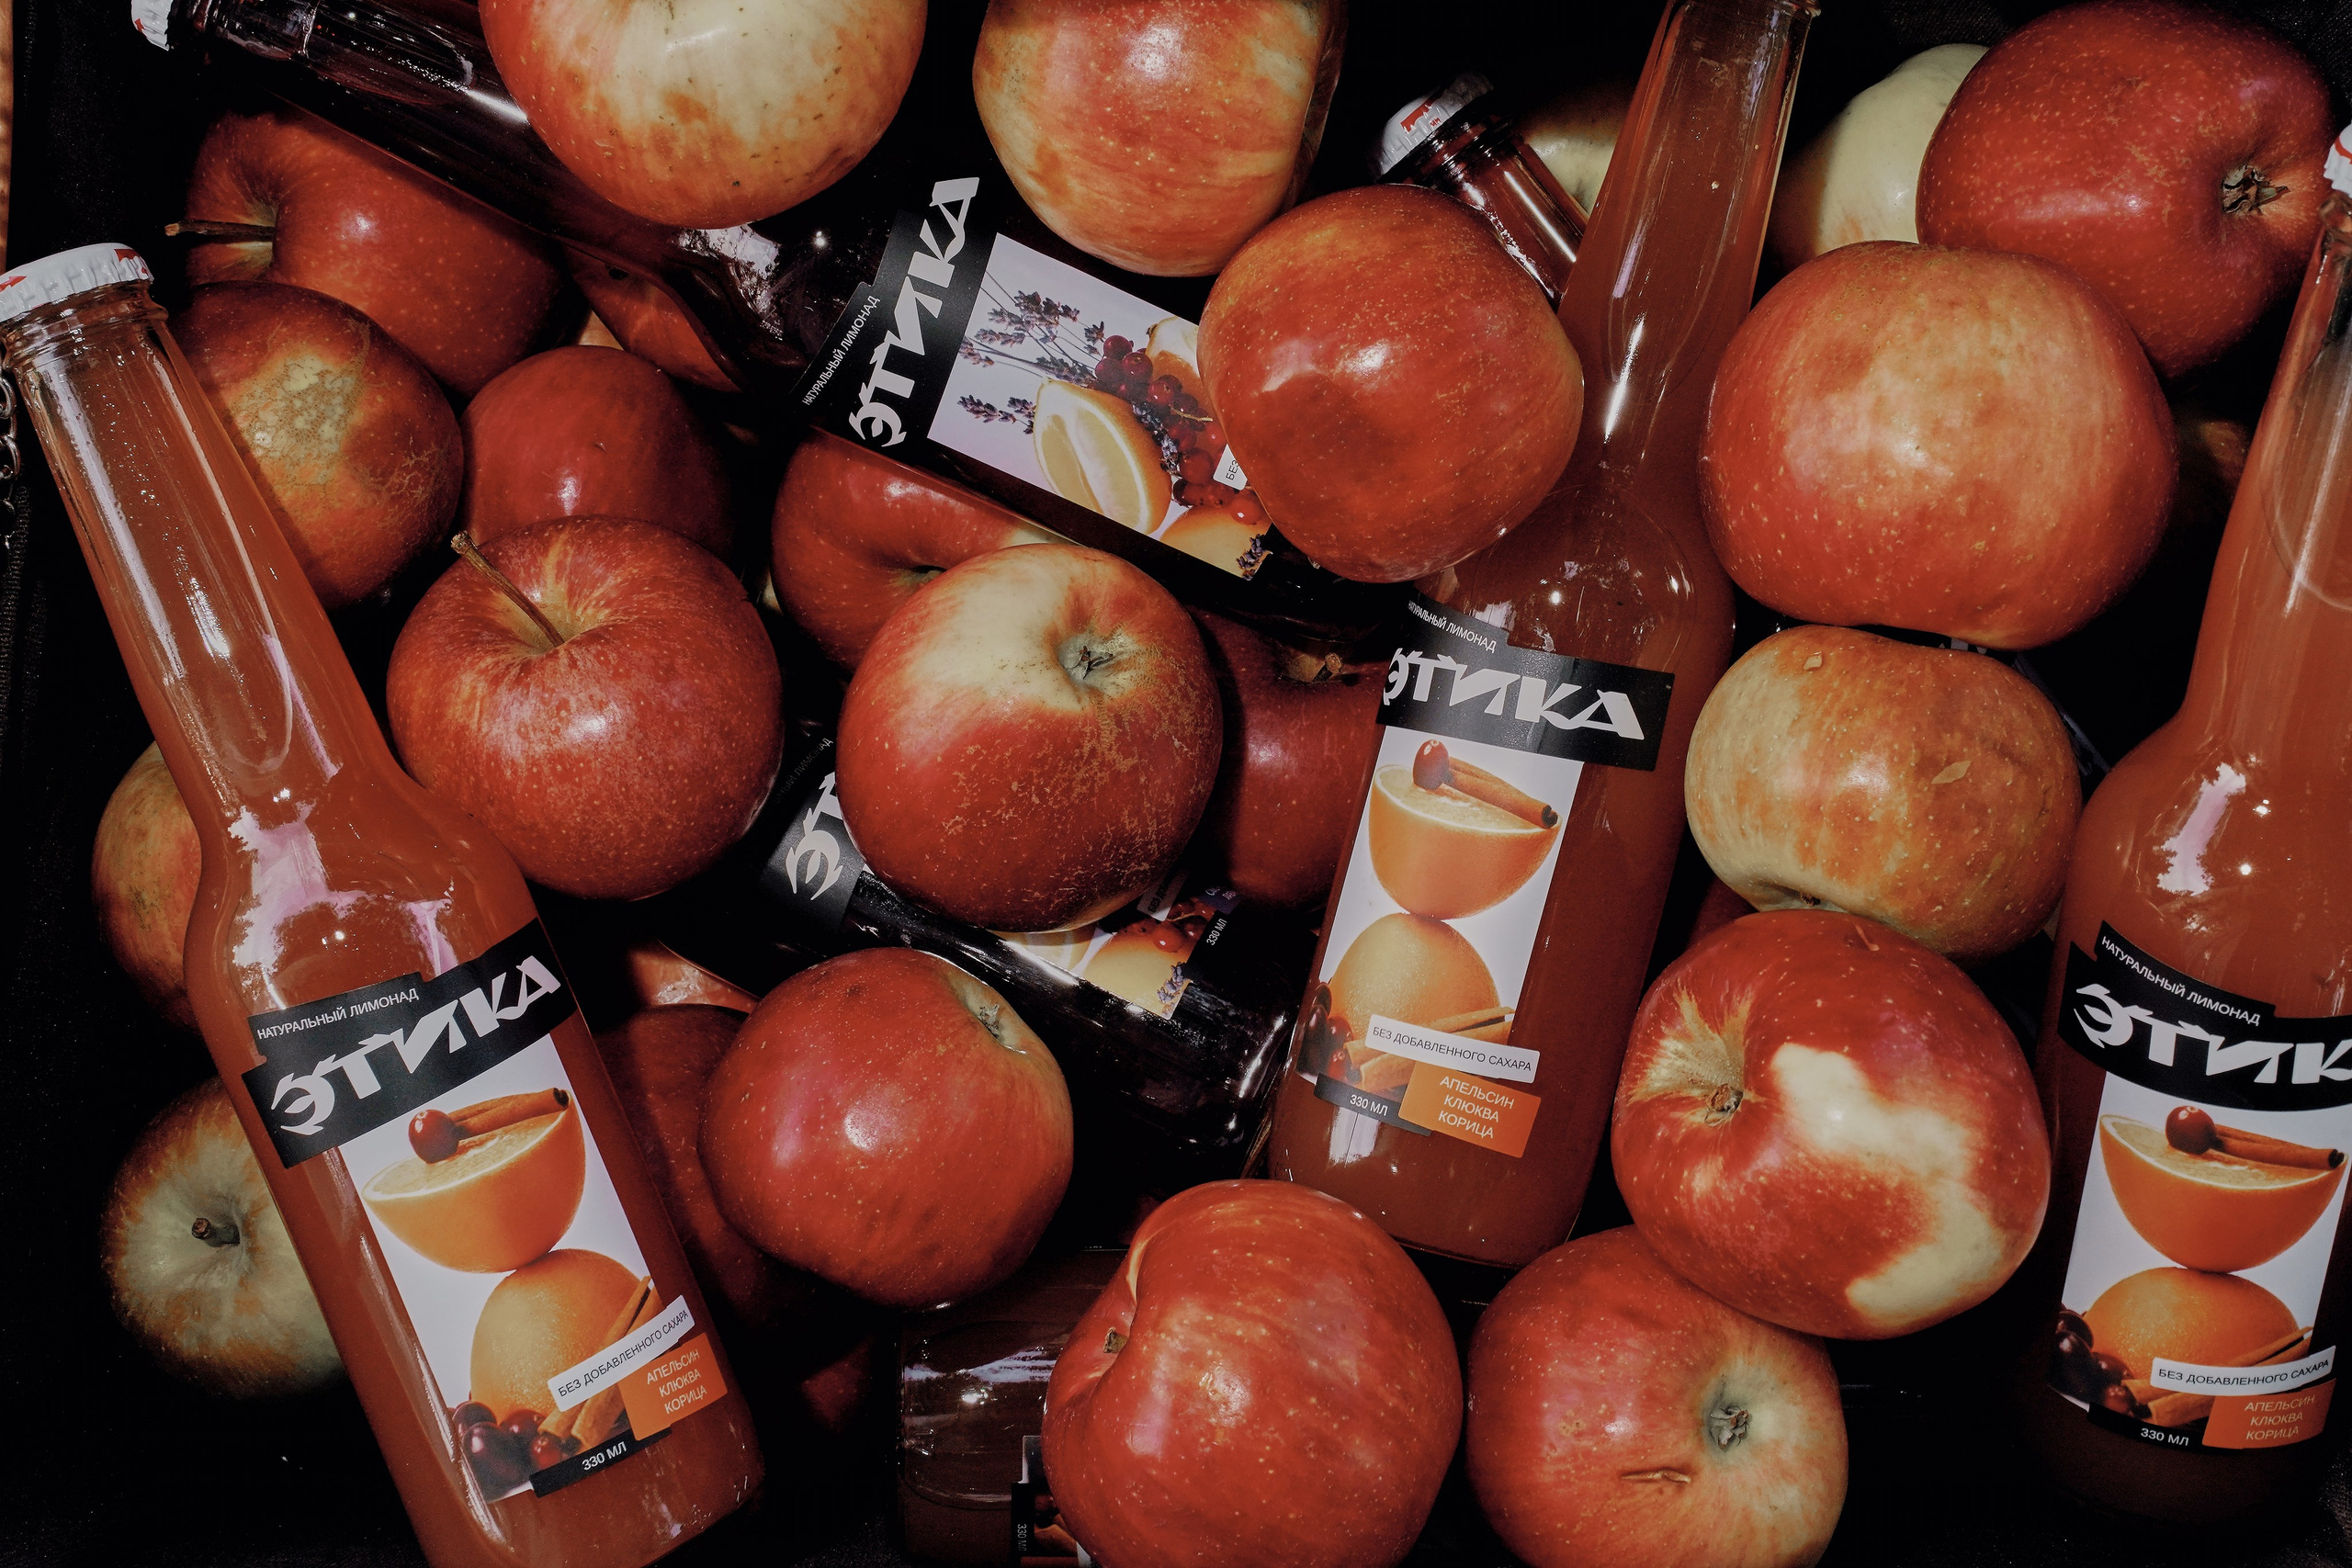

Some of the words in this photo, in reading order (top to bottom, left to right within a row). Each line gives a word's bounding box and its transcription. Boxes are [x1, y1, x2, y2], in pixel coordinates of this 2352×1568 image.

[849, 177, 979, 446] ЭТИКА
[802, 349, 845, 405] НАТУРАЛЬНЫЙ
[841, 295, 880, 351] ЛИМОНАД
[1226, 459, 1238, 480] БЕЗ
[1446, 623, 1497, 653] ЛИМОНАД
[1384, 648, 1645, 739] ЭТИКА
[1206, 930, 1220, 945] 330
[1215, 919, 1227, 931] МЛ
[2101, 935, 2186, 998] НАТУРАЛЬНЫЙ
[2187, 991, 2261, 1026] ЛИМОНАД
[256, 1006, 347, 1040] НАТУРАЛЬНЫЙ
[349, 987, 419, 1017] ЛИМОНАД
[270, 955, 561, 1135] ЭТИКА
[1373, 1026, 1392, 1040] БЕЗ
[1393, 1033, 1486, 1063] ДОБАВЛЕННОГО
[1488, 1055, 1532, 1072] САХАРА
[2074, 984, 2352, 1084] ЭТИК
[1350, 1094, 1367, 1110] 330
[1370, 1101, 1388, 1116] МЛ
[1440, 1076, 1515, 1109] АПЕЛЬСИН
[1444, 1095, 1499, 1122] КЛЮКВА
[1438, 1111, 1494, 1139] КОРИЦА
[558, 1379, 582, 1397] БЕЗ
[583, 1330, 662, 1386] ДОБАВЛЕННОГО
[662, 1310, 688, 1335] САХАРА
[647, 1348, 700, 1384] АПЕЛЬСИН
[659, 1369, 701, 1397] КЛЮКВА
[2158, 1369, 2183, 1381] БЕЗ
[2187, 1372, 2288, 1386] ДОБАВЛЕННОГО
[2290, 1359, 2329, 1379] САХАРА
[664, 1385, 707, 1414] КОРИЦА
[2245, 1394, 2315, 1412] АПЕЛЬСИН
[2245, 1427, 2300, 1441] КОРИЦА
[2250, 1412, 2303, 1427] КЛЮКВА
[2141, 1427, 2165, 1441] 330
[2167, 1435, 2189, 1447] МЛ
[582, 1452, 605, 1471] 330
[606, 1441, 627, 1460] МЛ
